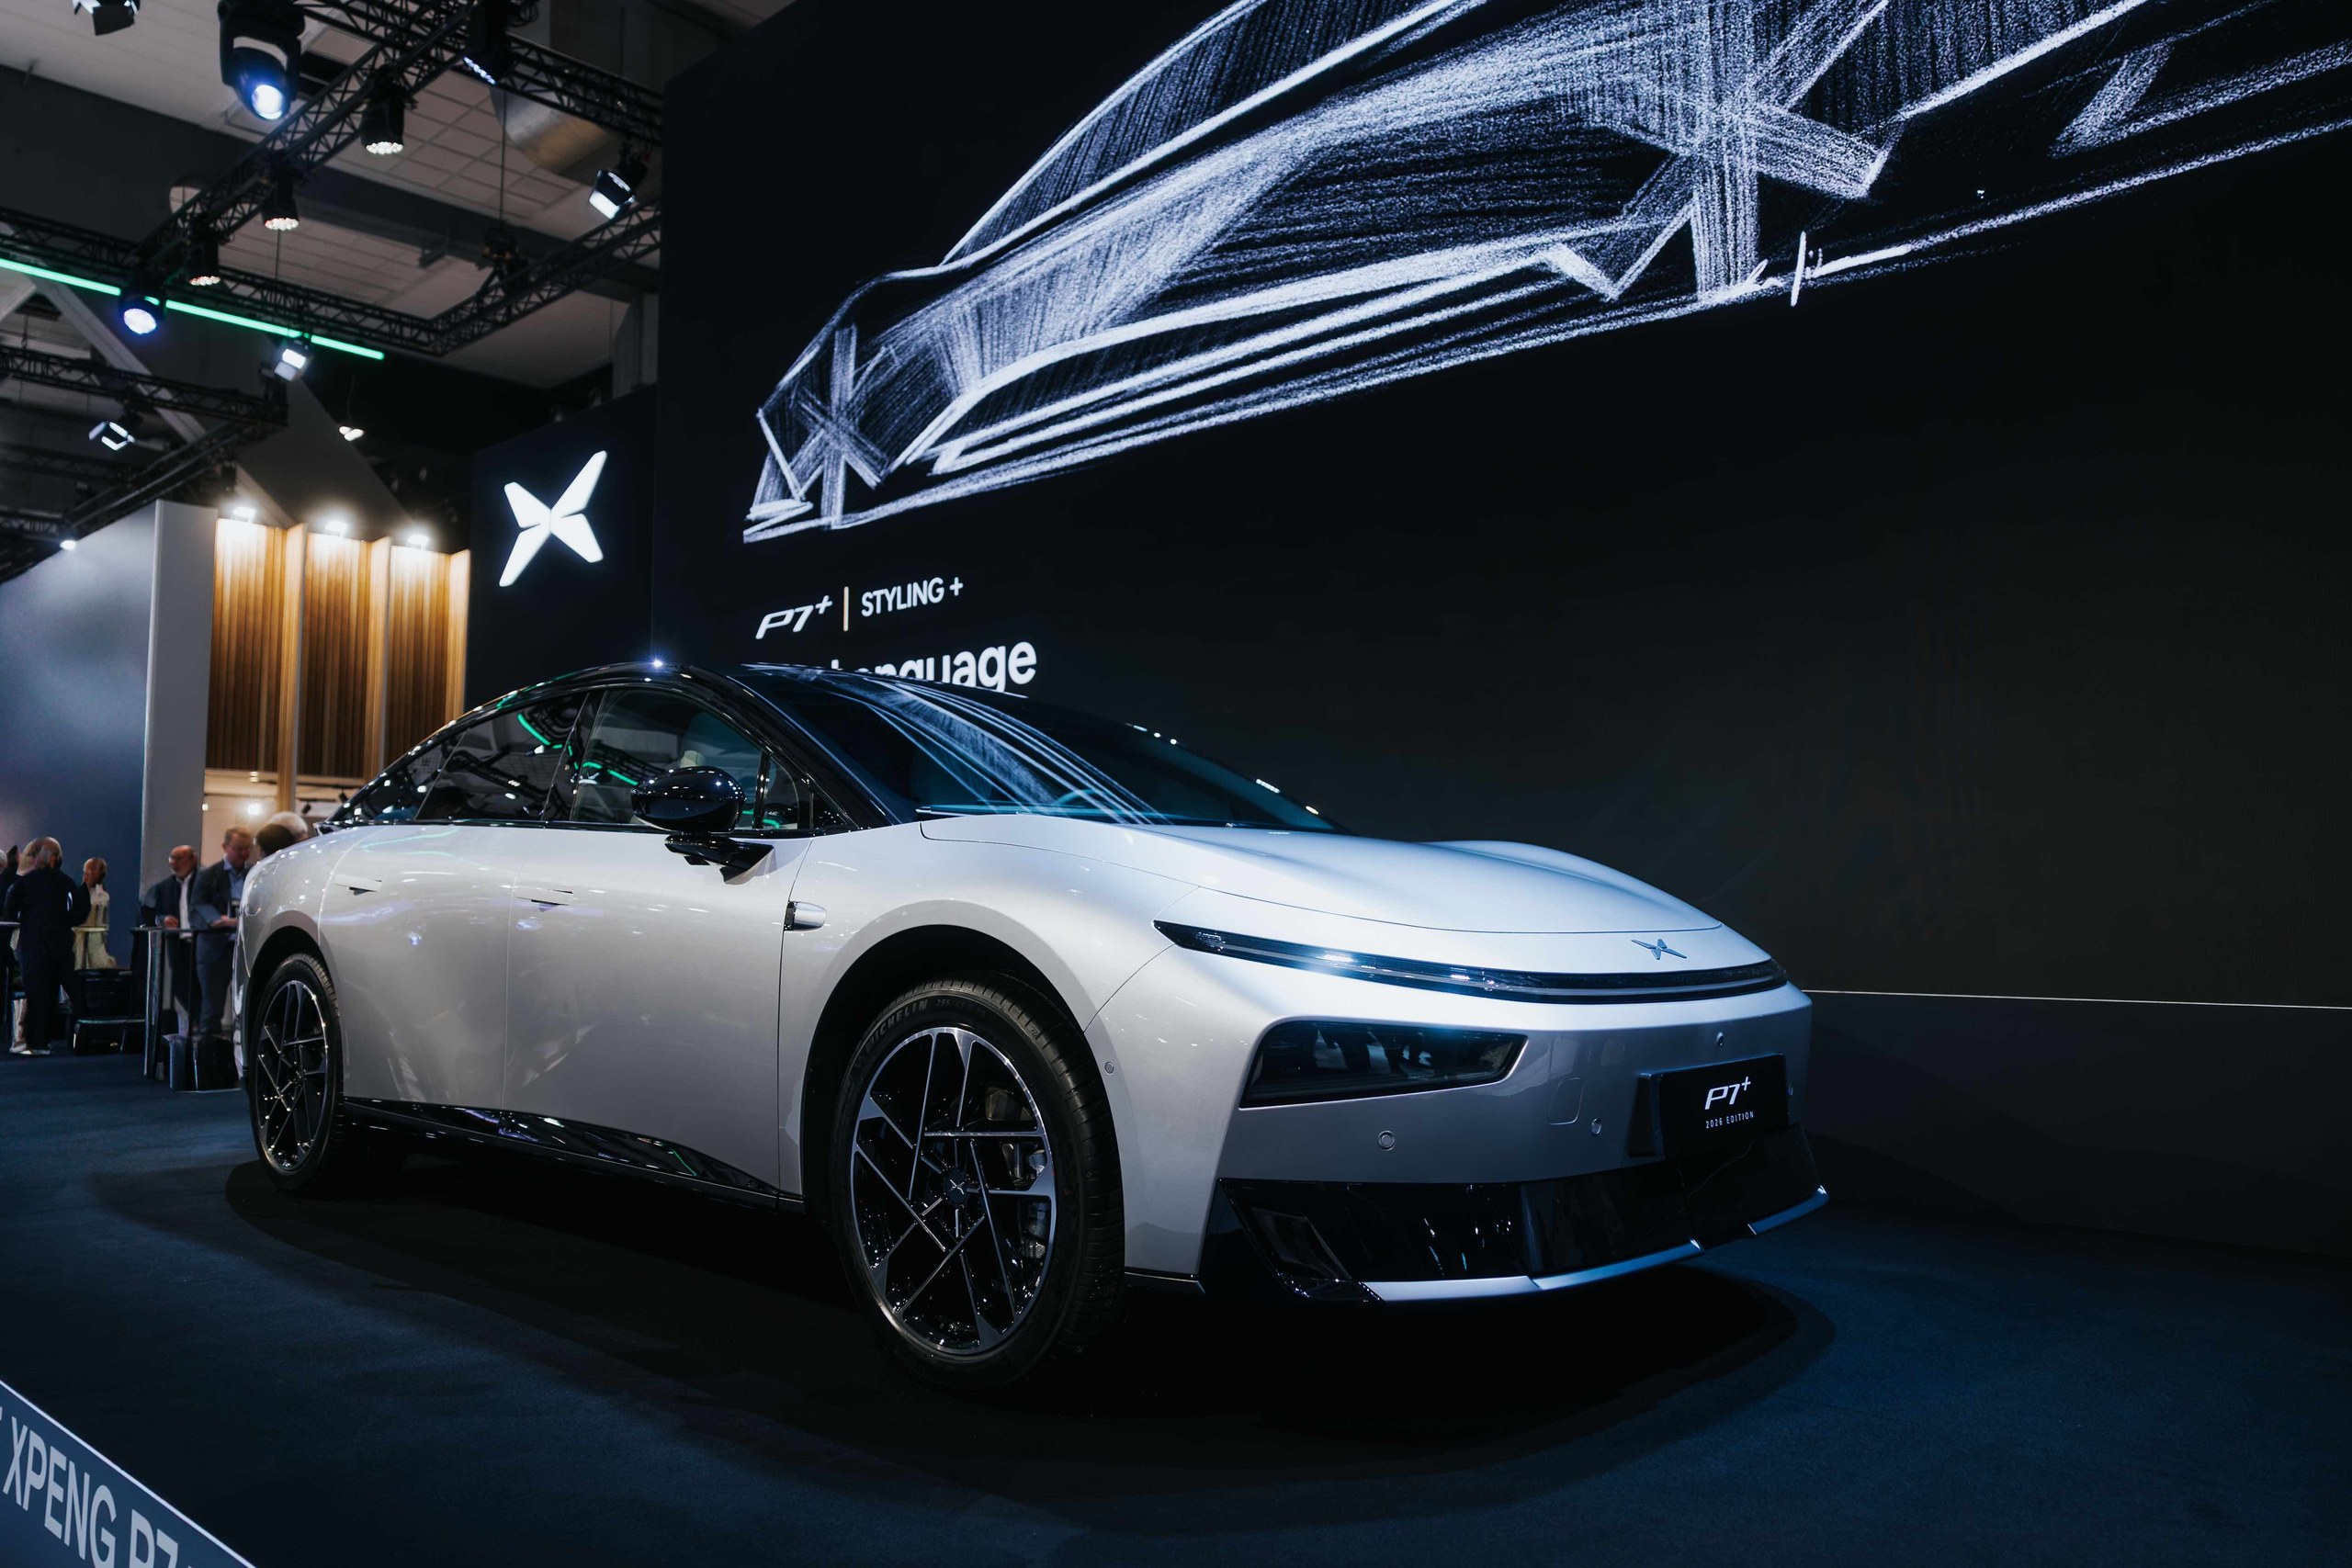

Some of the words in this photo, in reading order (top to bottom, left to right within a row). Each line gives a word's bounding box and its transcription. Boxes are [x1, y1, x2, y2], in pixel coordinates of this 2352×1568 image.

[755, 594, 833, 640] P7+
[861, 577, 945, 617] STYLING
[865, 998, 928, 1053] MICHELIN
[1704, 1076, 1751, 1110] P7+
[1705, 1117, 1724, 1129] 2026
[1725, 1111, 1754, 1124] EDITION
[2, 1416, 117, 1568] XPENG
